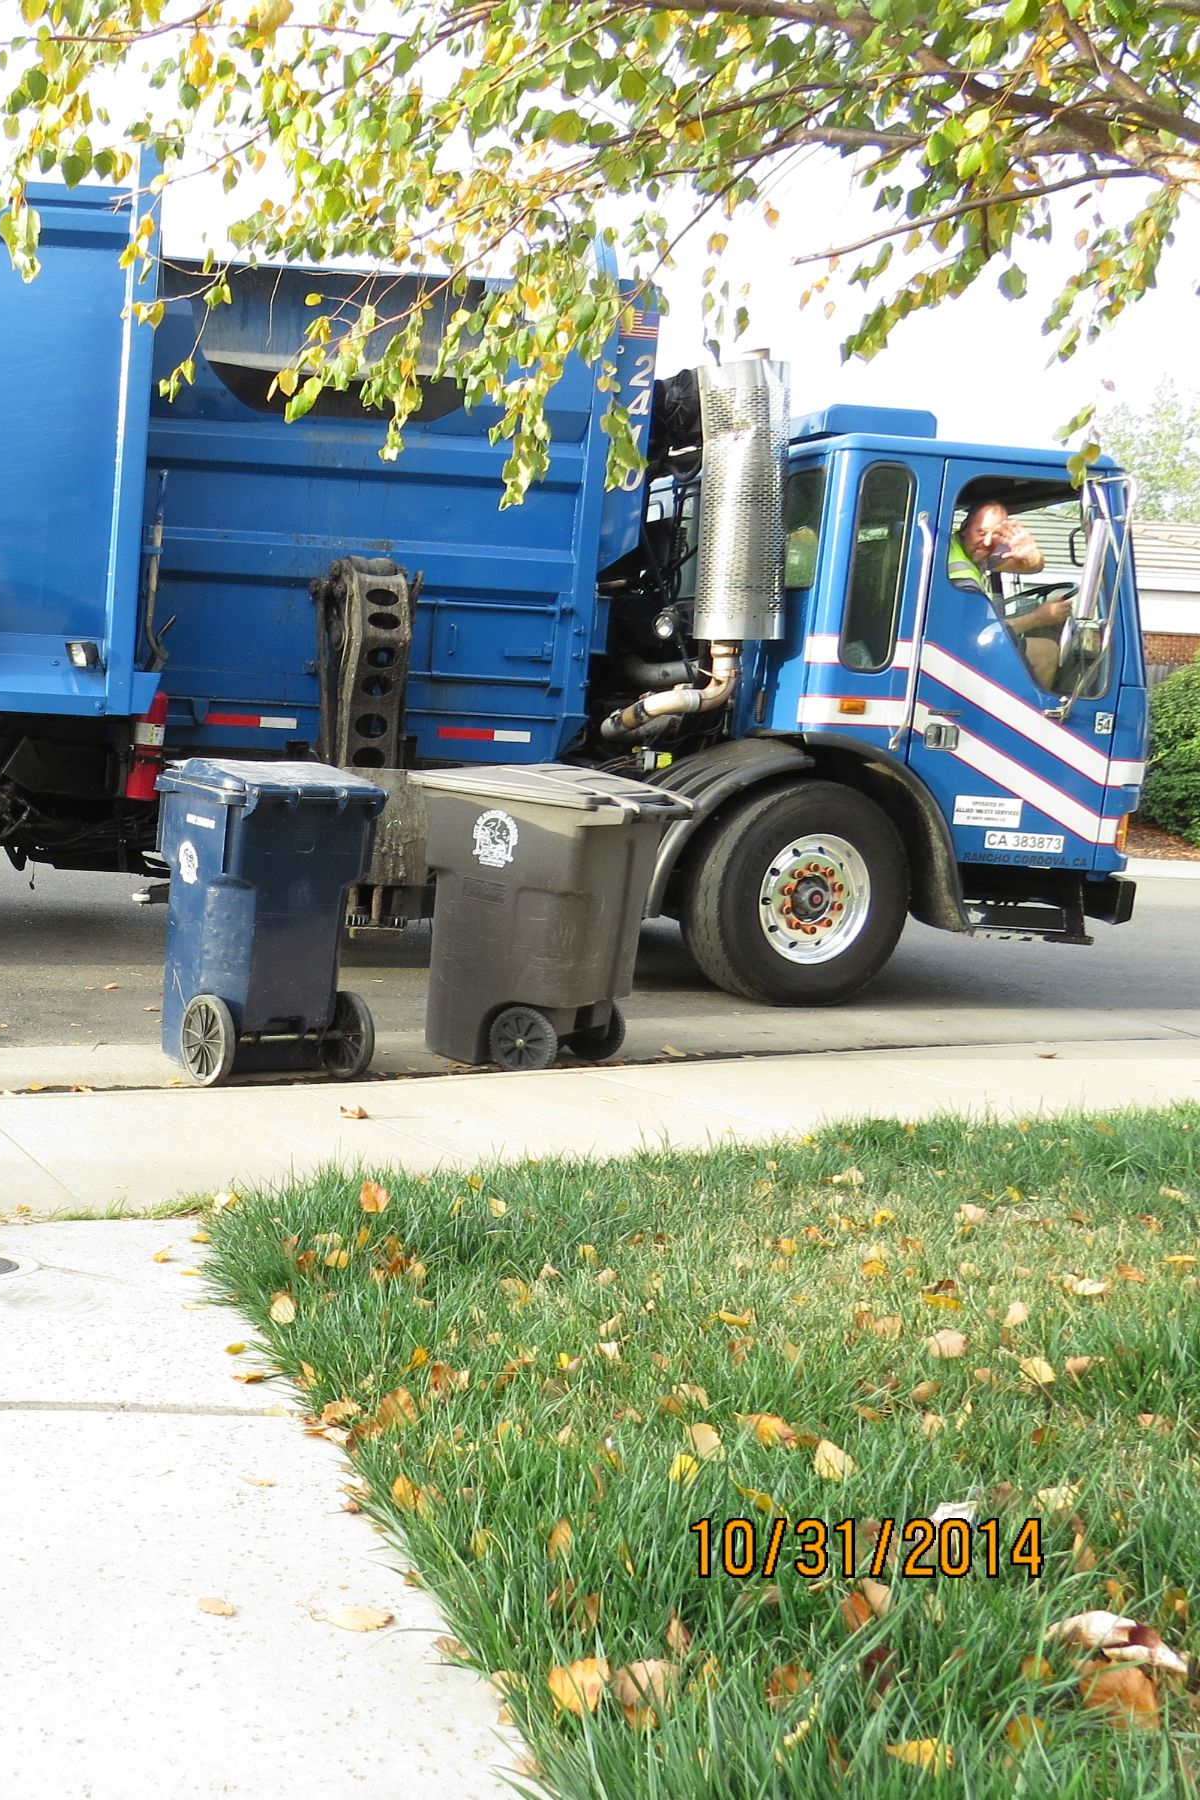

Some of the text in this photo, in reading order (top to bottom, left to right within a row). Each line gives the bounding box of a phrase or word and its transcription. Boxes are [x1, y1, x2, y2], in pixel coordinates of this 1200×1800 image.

[1097, 718, 1111, 732] 54
[987, 833, 1062, 850] CA 383873
[963, 852, 1010, 864] RANCHO
[1072, 857, 1088, 867] CA
